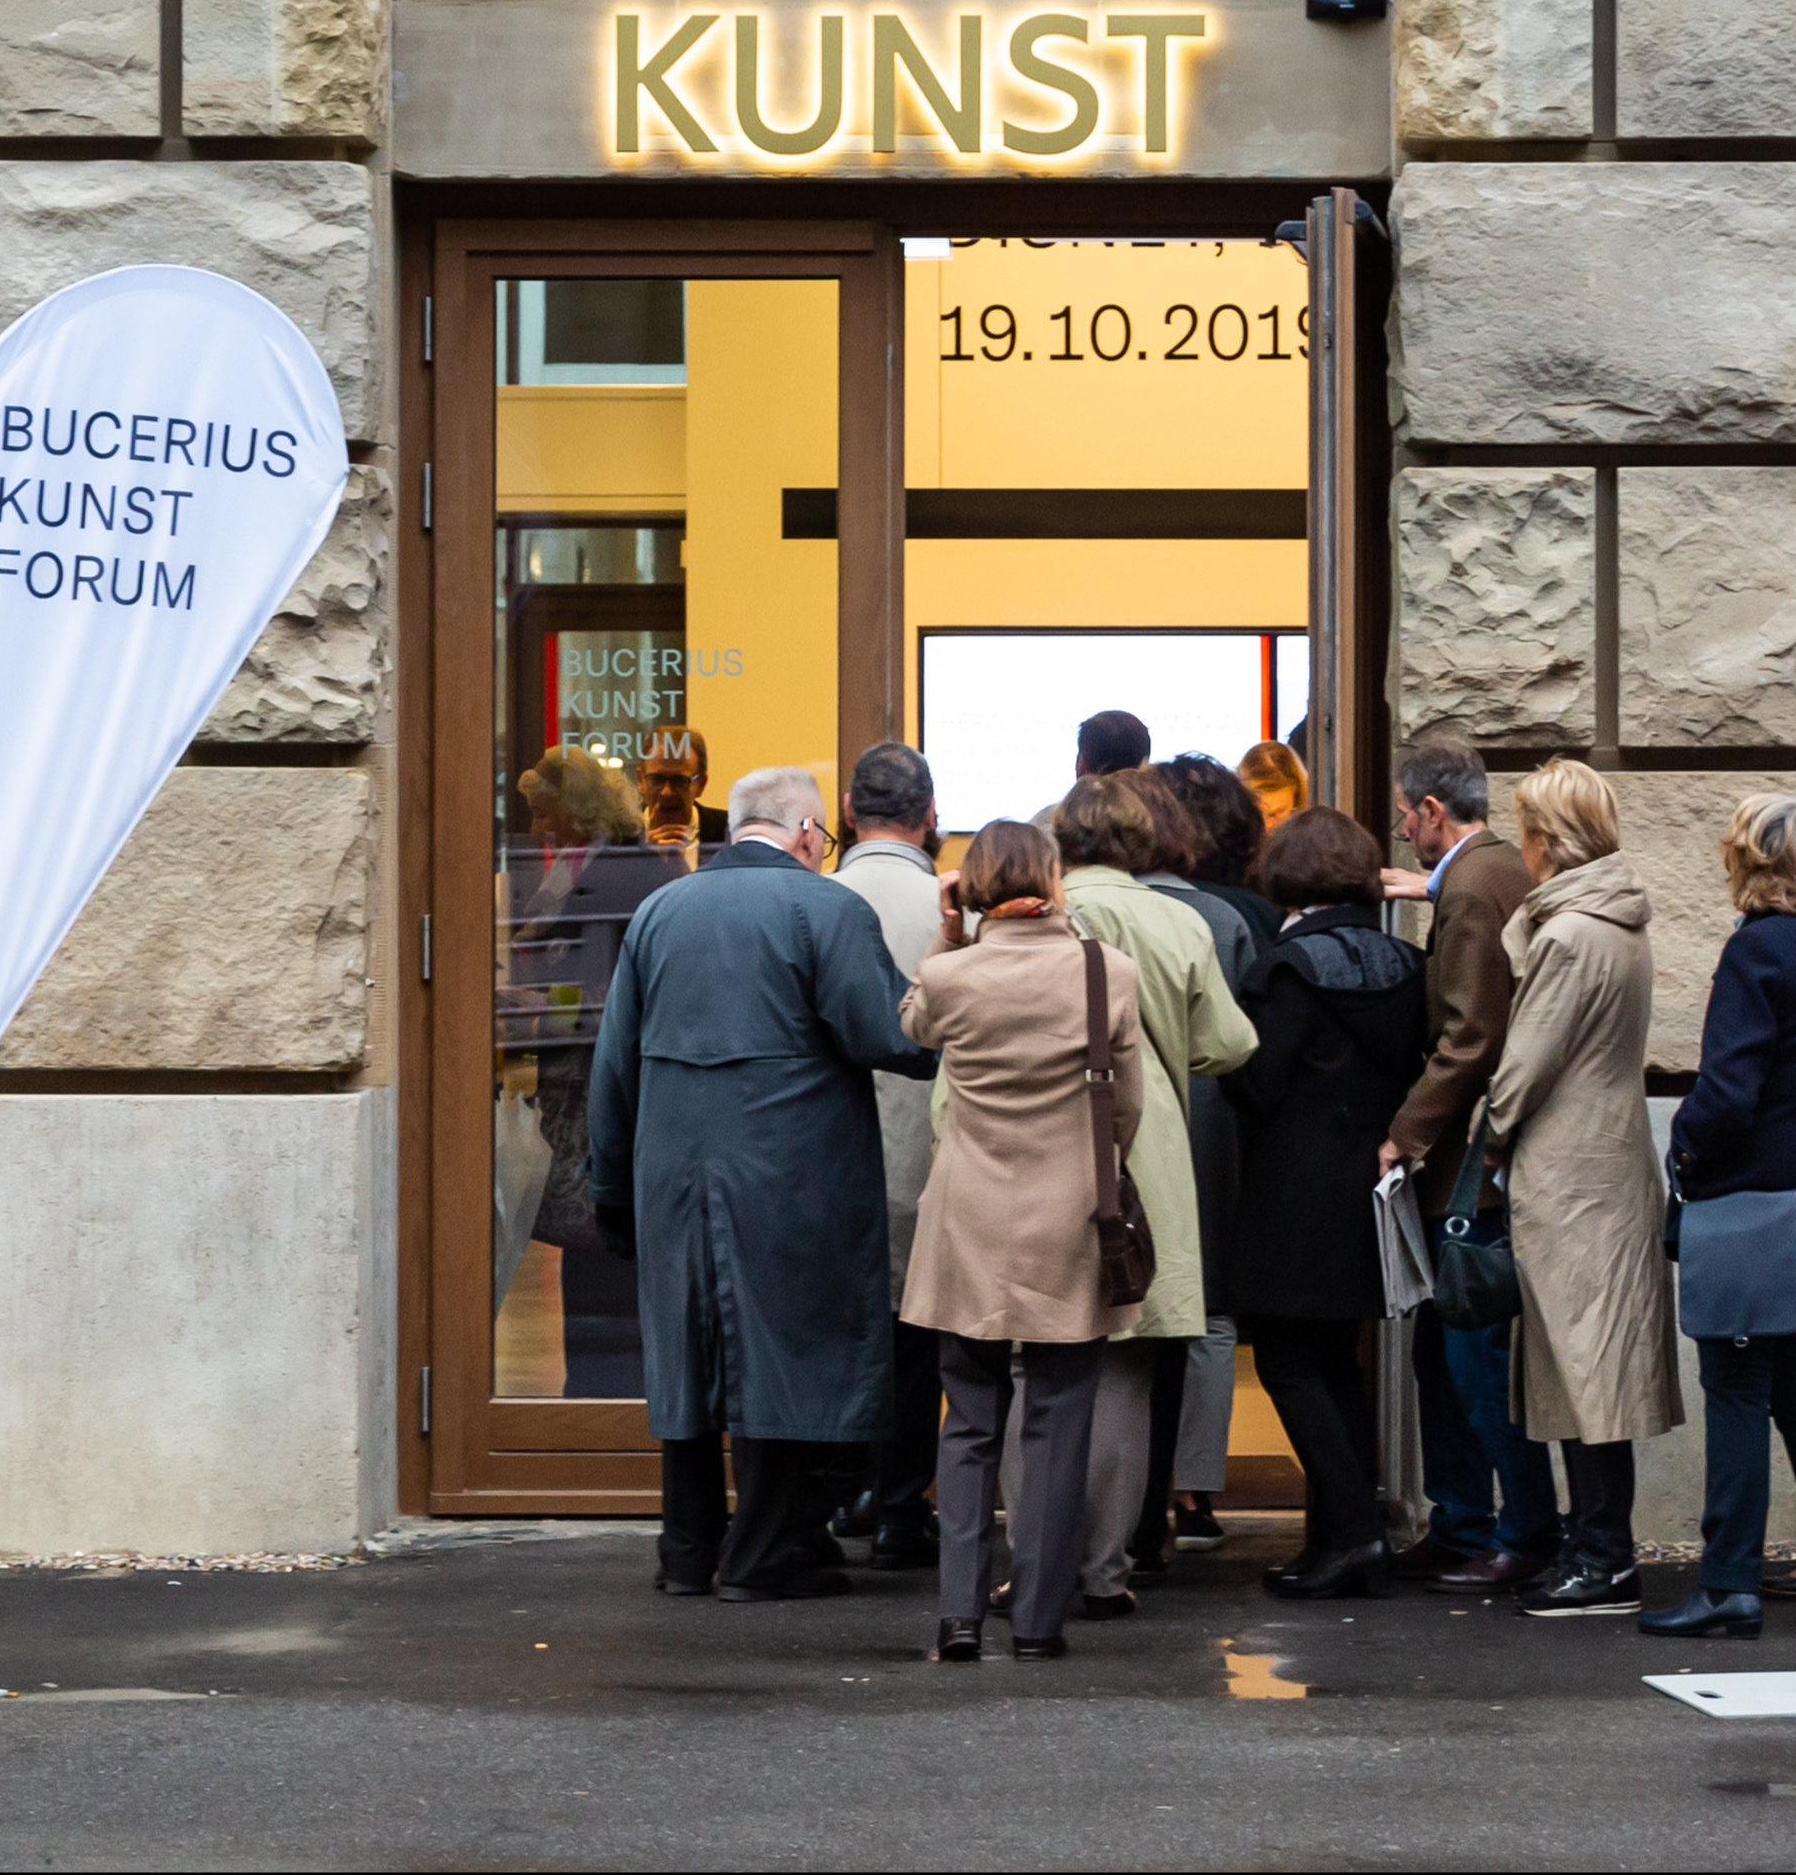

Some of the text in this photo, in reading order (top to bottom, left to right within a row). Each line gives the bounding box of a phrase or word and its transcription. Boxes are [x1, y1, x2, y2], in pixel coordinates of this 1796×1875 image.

[614, 12, 1206, 156] KUNST
[1, 404, 298, 477] BUCERIUS
[560, 648, 744, 677] BUCERIUS
[560, 689, 684, 718] KUNST
[561, 731, 692, 761] FORUM
